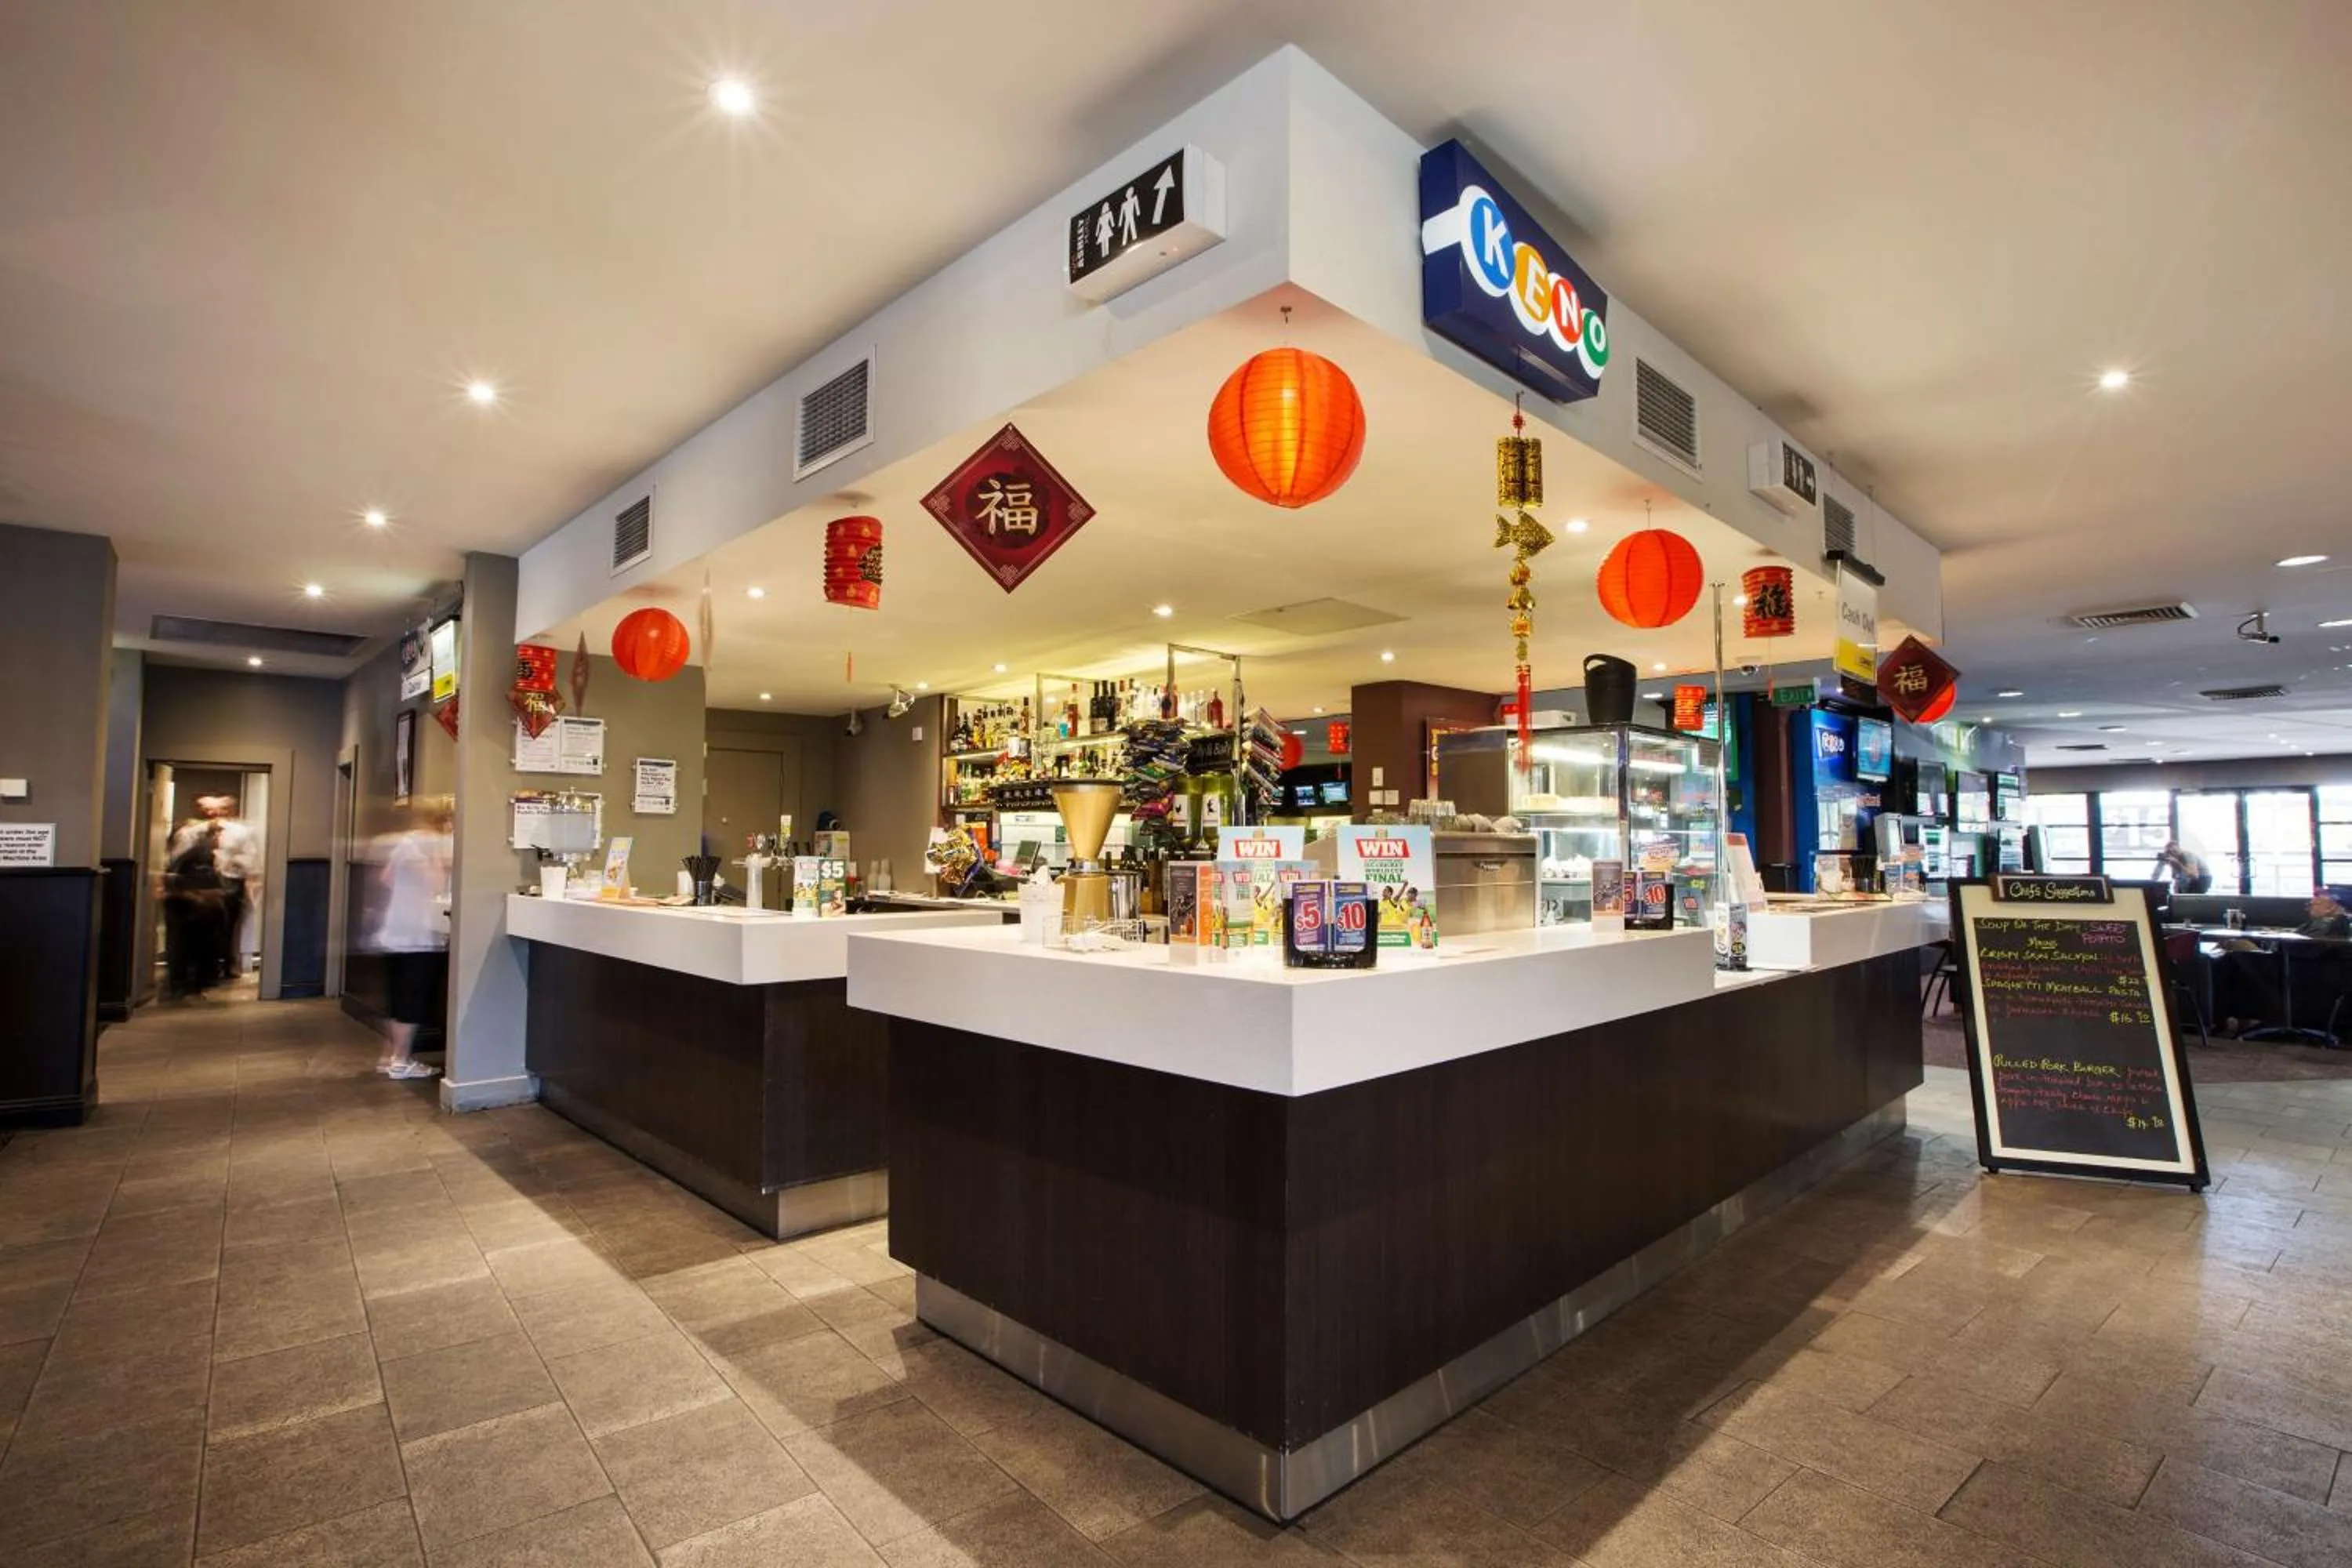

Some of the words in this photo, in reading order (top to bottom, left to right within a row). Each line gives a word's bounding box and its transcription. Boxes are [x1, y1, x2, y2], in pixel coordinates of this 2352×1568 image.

[1481, 204, 1606, 353] KENO
[975, 478, 1040, 536] 福
[1893, 664, 1928, 695] 福
[1238, 840, 1278, 858] WIN
[1360, 840, 1404, 857] WIN
[821, 860, 844, 878] $5
[1365, 873, 1405, 884] FINAL
[1295, 902, 1320, 931] $5
[1337, 902, 1365, 931] $10
